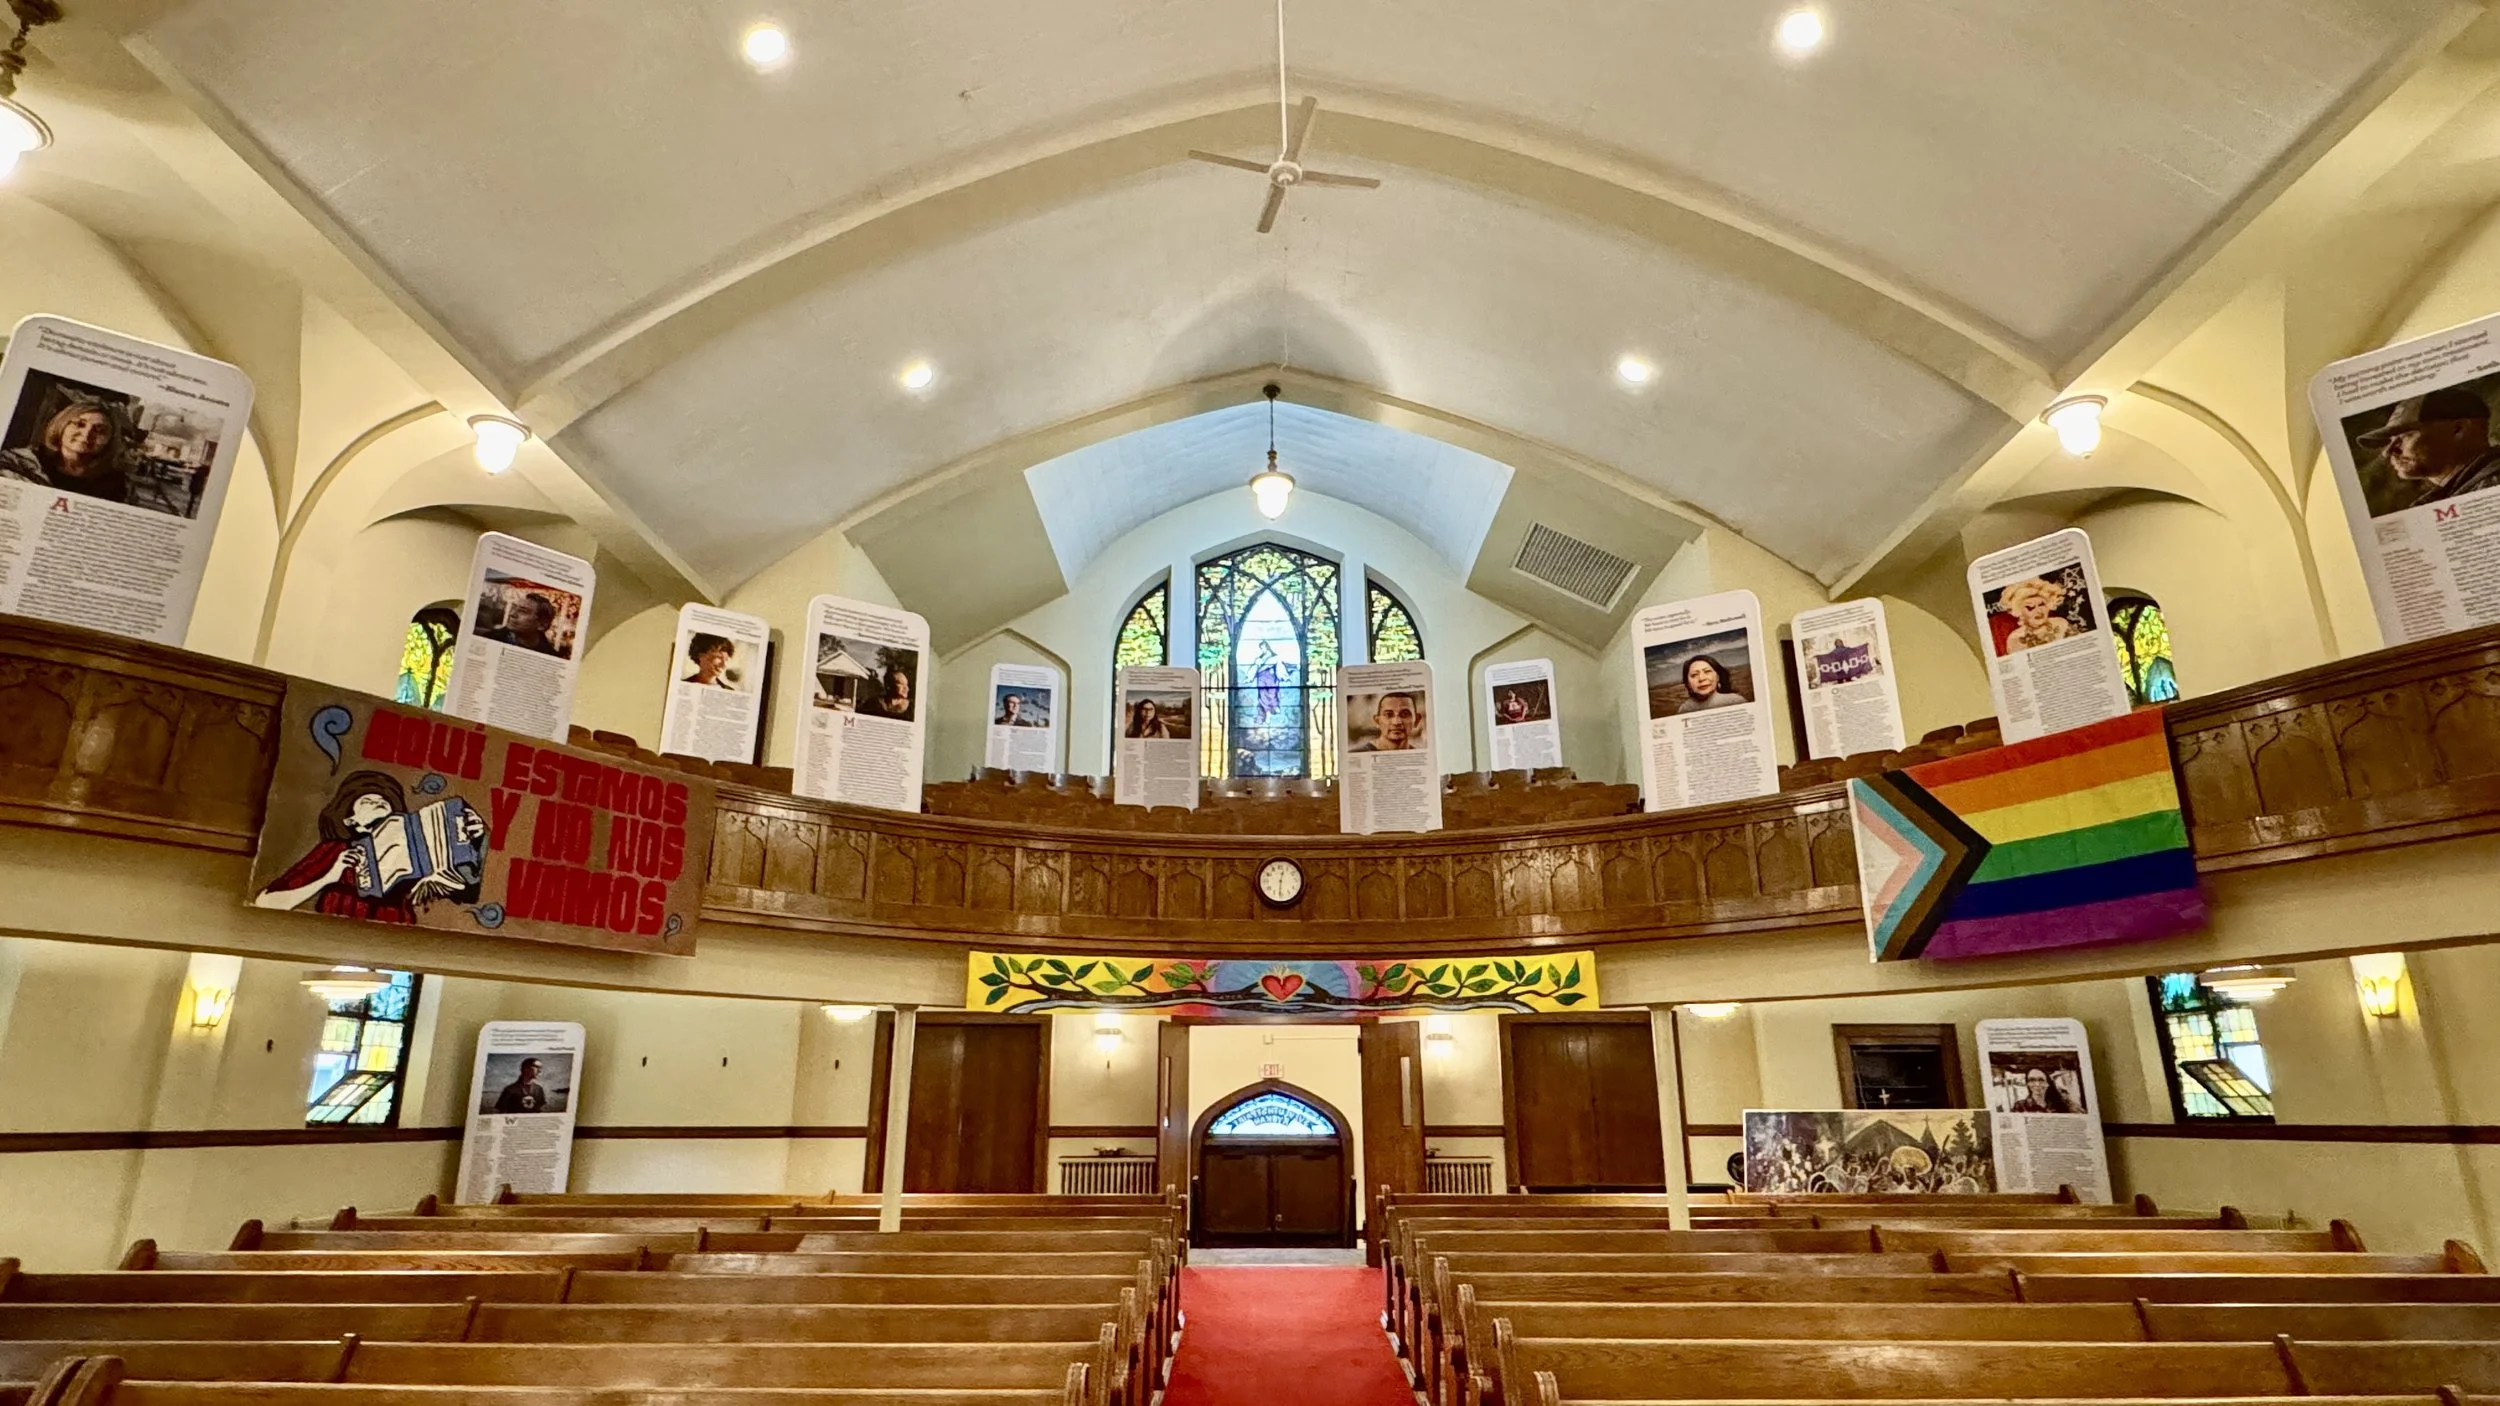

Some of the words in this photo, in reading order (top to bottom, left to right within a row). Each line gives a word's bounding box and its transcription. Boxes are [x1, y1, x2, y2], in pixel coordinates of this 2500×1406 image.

[362, 708, 487, 780] AQUÍ
[502, 742, 688, 827] ESTAMOS
[489, 788, 521, 852] Y
[532, 799, 594, 866] NO
[608, 814, 687, 882] NOS
[505, 857, 667, 936] VAMOS
[1264, 1064, 1280, 1076] EXIT
